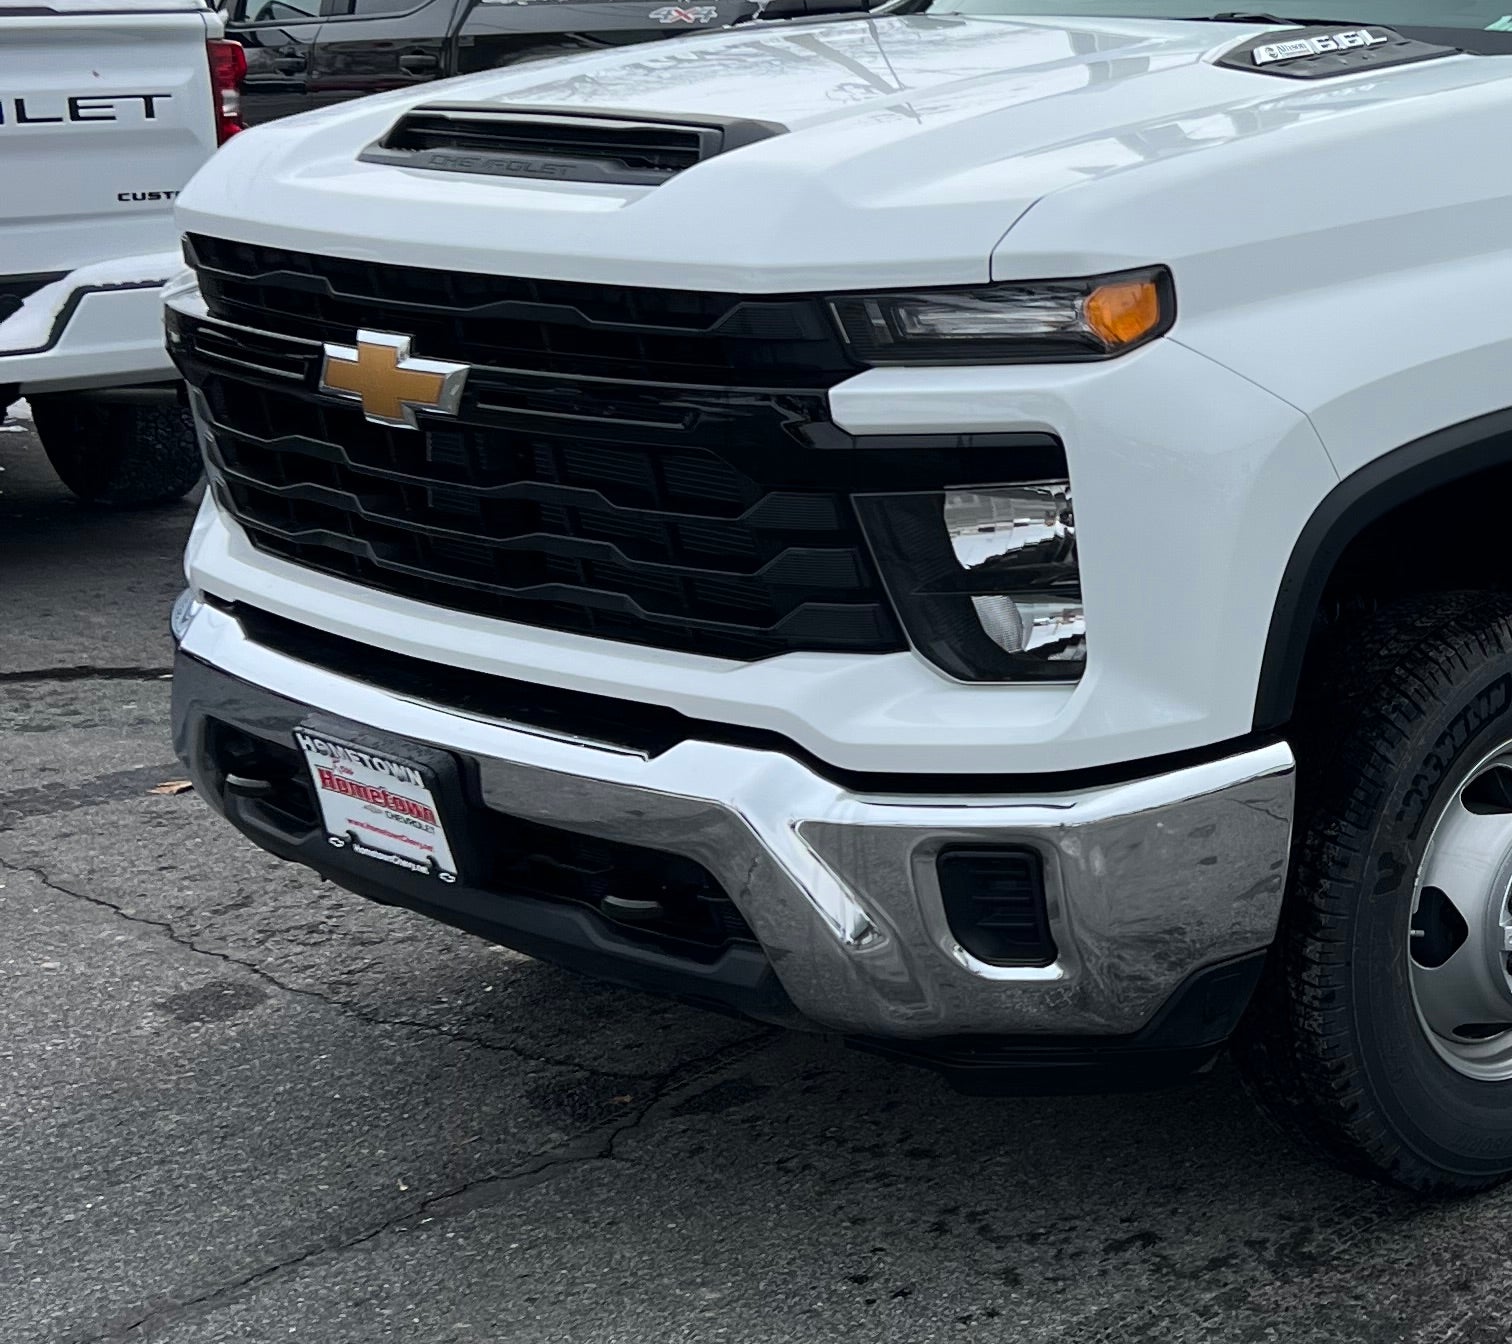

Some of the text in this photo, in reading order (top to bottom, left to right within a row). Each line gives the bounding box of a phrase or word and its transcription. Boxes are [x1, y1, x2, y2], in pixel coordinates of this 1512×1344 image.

[428, 154, 578, 178] CHEVROLET
[296, 733, 426, 790] HOMETOWN
[317, 767, 437, 826] Hometown
[385, 810, 435, 834] CHEVROLET
